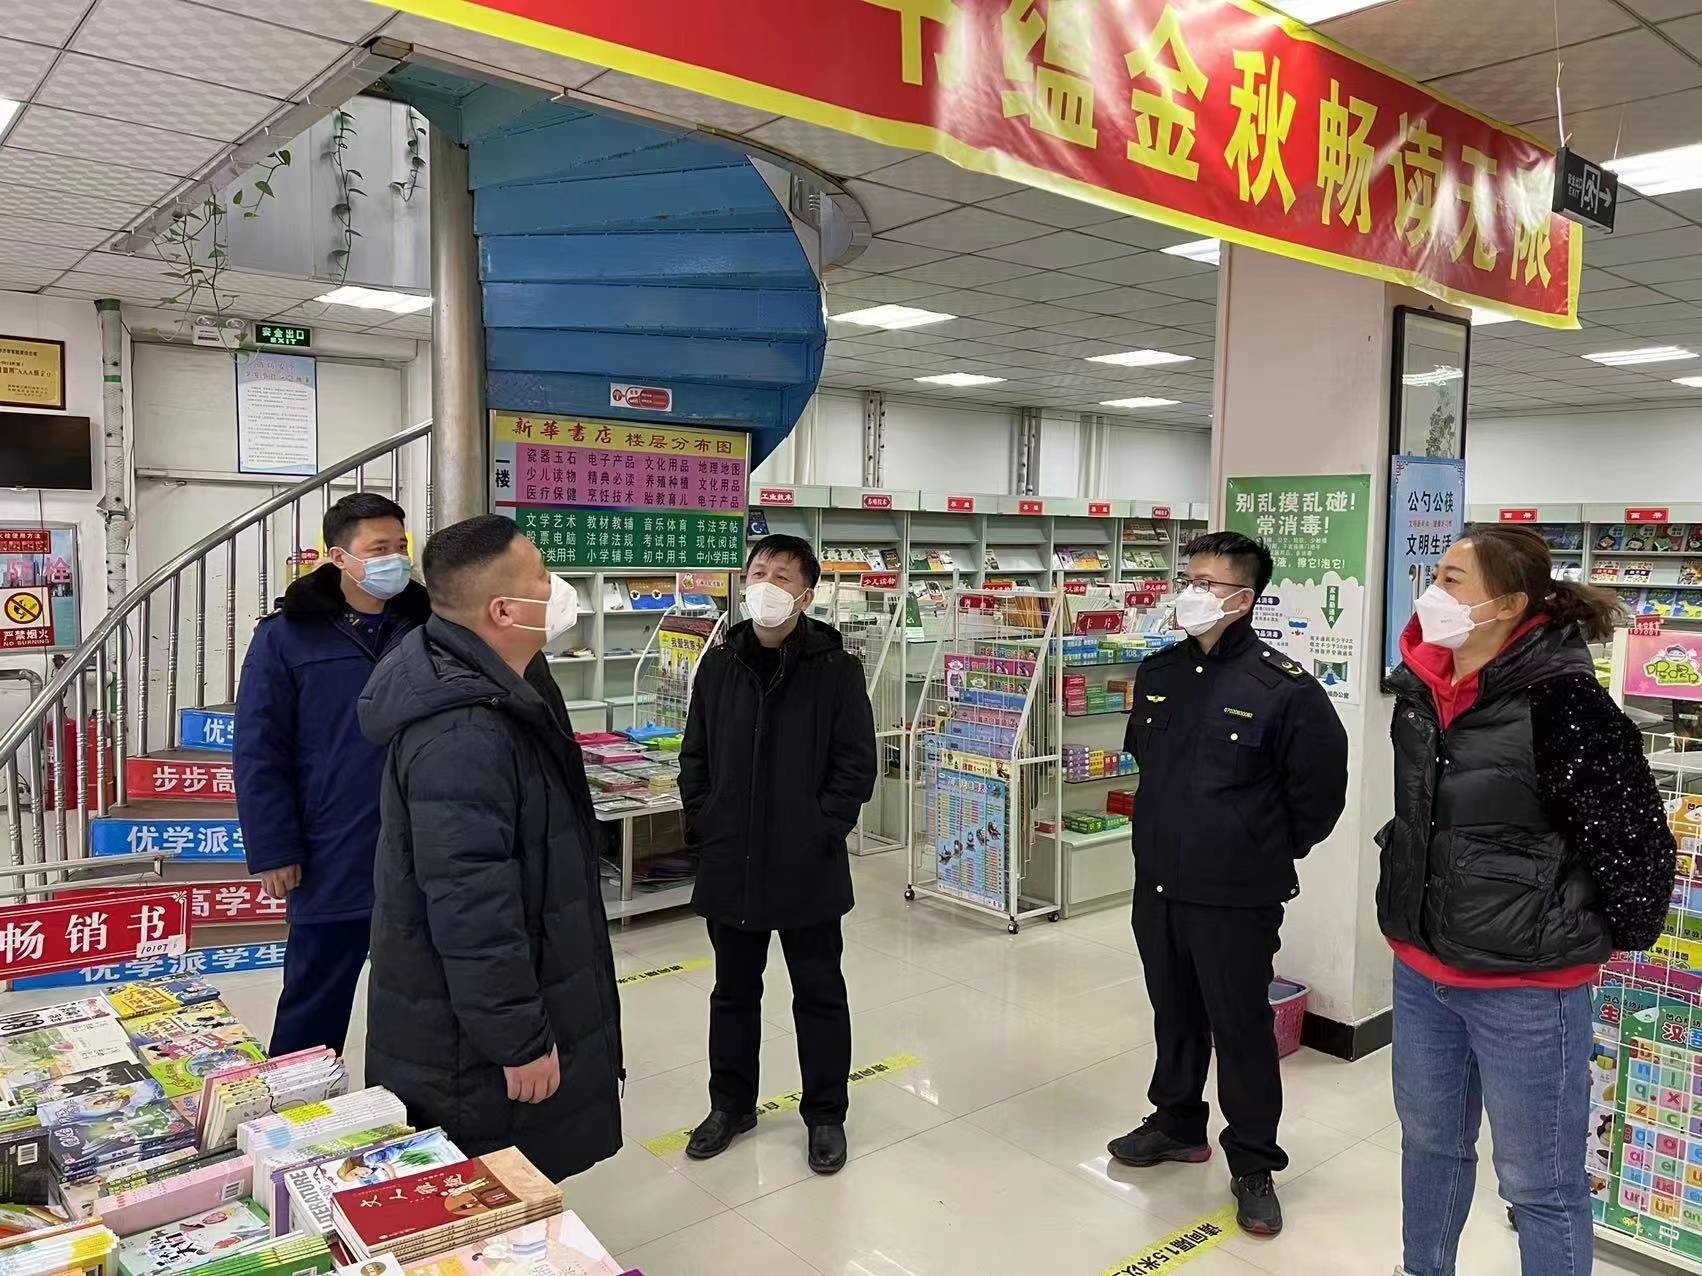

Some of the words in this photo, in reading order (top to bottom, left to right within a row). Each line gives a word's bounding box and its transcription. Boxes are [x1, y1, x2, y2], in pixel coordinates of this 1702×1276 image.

[1569, 186, 1581, 199] EXIT
[262, 326, 304, 340] 安全出口
[625, 432, 732, 454] 楼层分布图
[527, 448, 577, 465] 瓷器玉石
[588, 454, 635, 469] 电子产品
[644, 456, 689, 473] 文化用品
[698, 460, 740, 476] 地理地图
[495, 459, 511, 488] 一楼
[527, 468, 577, 484] 少儿读物
[588, 471, 635, 487] 精典必读
[645, 474, 689, 490] 养殖种植
[698, 477, 740, 492] 文化用品
[527, 484, 577, 502] 医疗保健
[588, 488, 634, 504] 烹饪技术
[644, 491, 688, 507] 胎教育儿
[698, 494, 740, 509] 电子产品
[1408, 491, 1454, 512] 公勺公筷
[526, 512, 577, 528] 文学艺术
[587, 515, 634, 531] 教材教辅
[644, 518, 688, 533] 音乐体育
[697, 520, 738, 534] 书法字帖
[1256, 515, 1329, 536] 常消毒!
[587, 532, 634, 548] 法律法规
[644, 534, 688, 548] 考试用书
[696, 535, 738, 549] 现代阅读
[1406, 534, 1452, 555] 文明生活
[587, 548, 634, 564] 小学辅导
[644, 550, 688, 564] 初中用书
[697, 550, 738, 564] 中小学用书
[4, 630, 48, 641] 严禁烟火
[203, 717, 235, 744] 优
[153, 765, 236, 793] 步步高
[0, 905, 165, 964] 畅销书
[1668, 1092, 1680, 1104] x
[1634, 1104, 1646, 1116] z
[1667, 1114, 1678, 1125] c
[290, 1170, 332, 1230] LITERATURE
